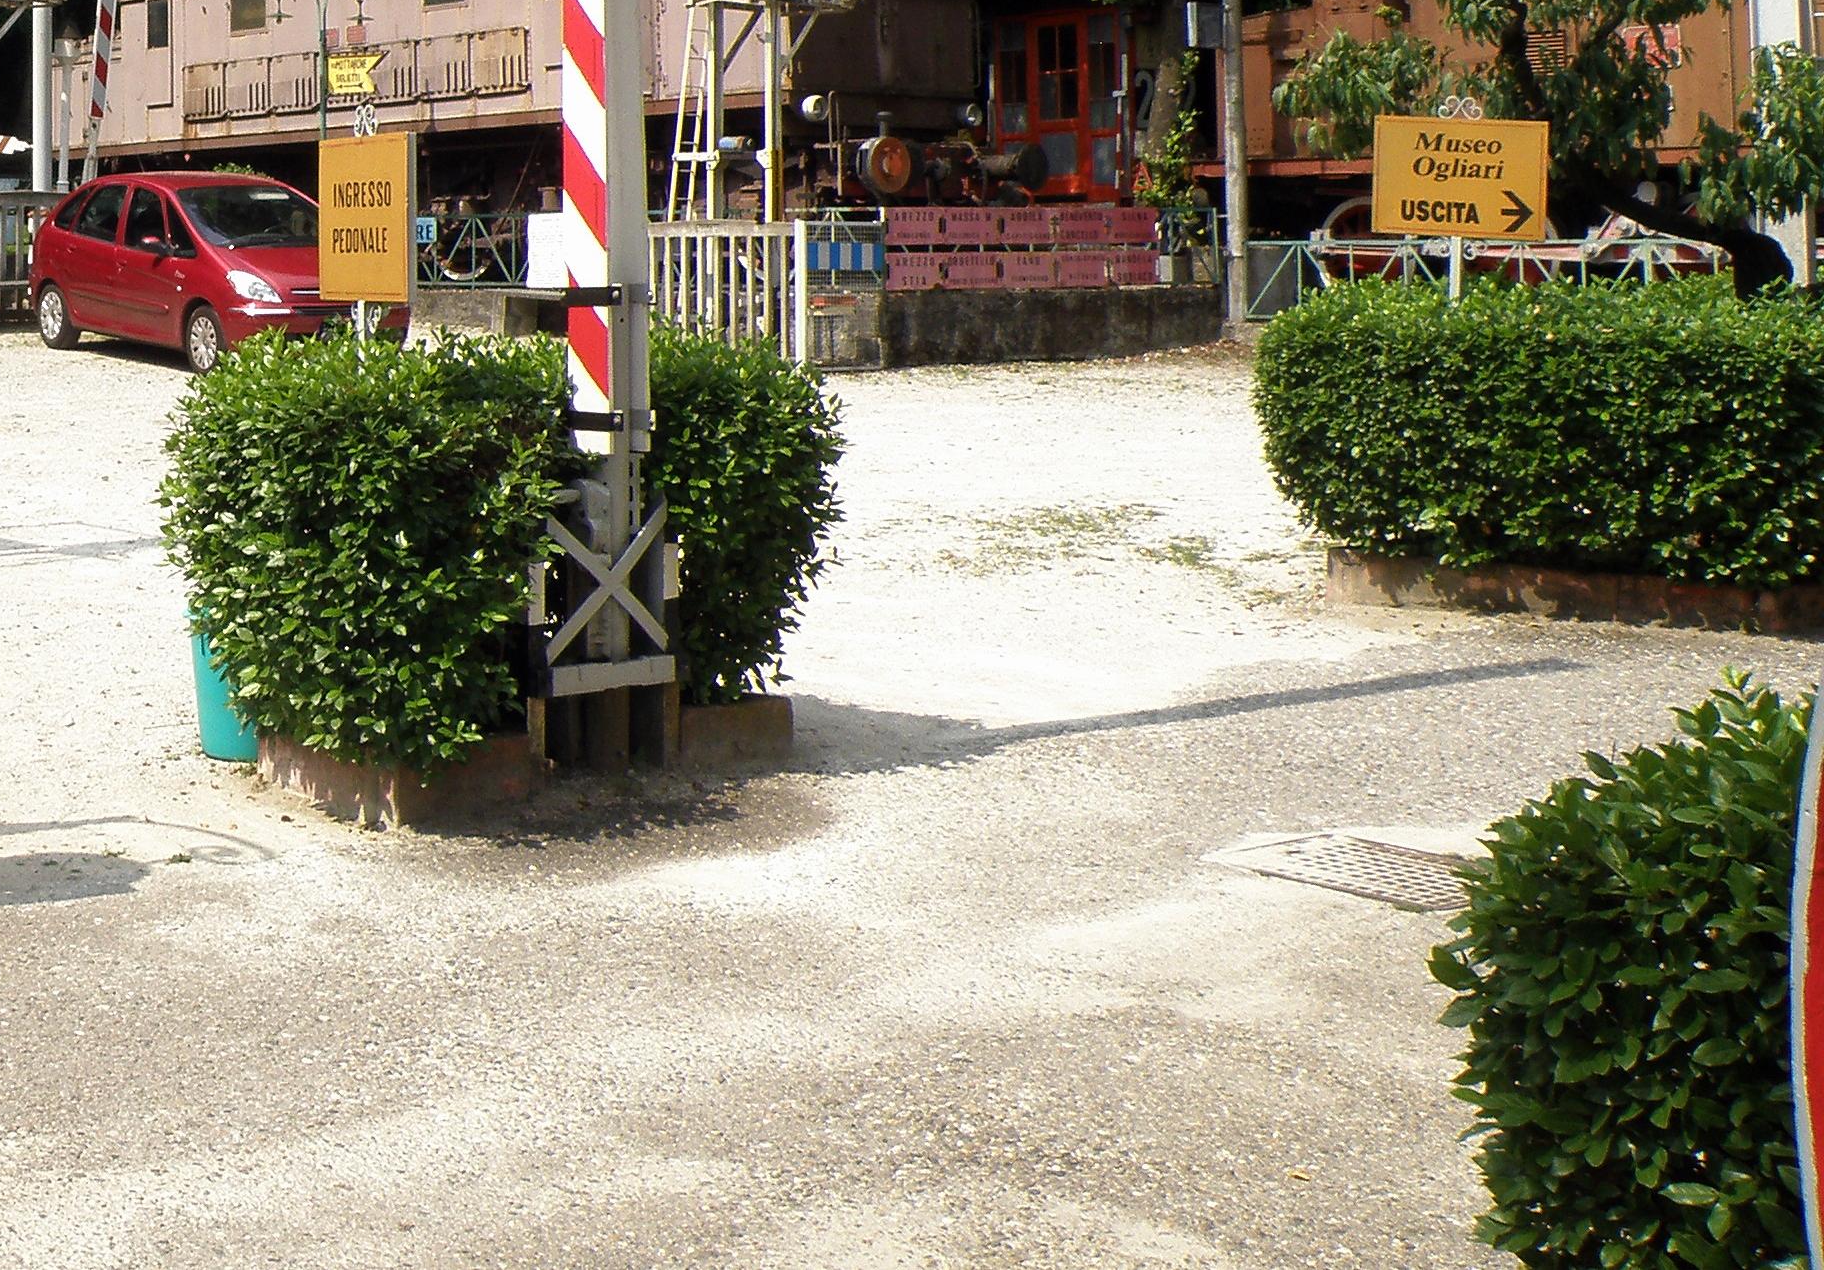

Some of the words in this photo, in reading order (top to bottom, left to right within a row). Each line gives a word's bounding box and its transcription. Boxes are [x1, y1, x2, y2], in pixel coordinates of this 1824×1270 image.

[1413, 132, 1503, 154] Museo
[1412, 156, 1505, 182] Ogliari
[333, 180, 392, 208] INGRESSO
[1401, 200, 1480, 225] USCITA
[332, 227, 388, 254] PEDONALE
